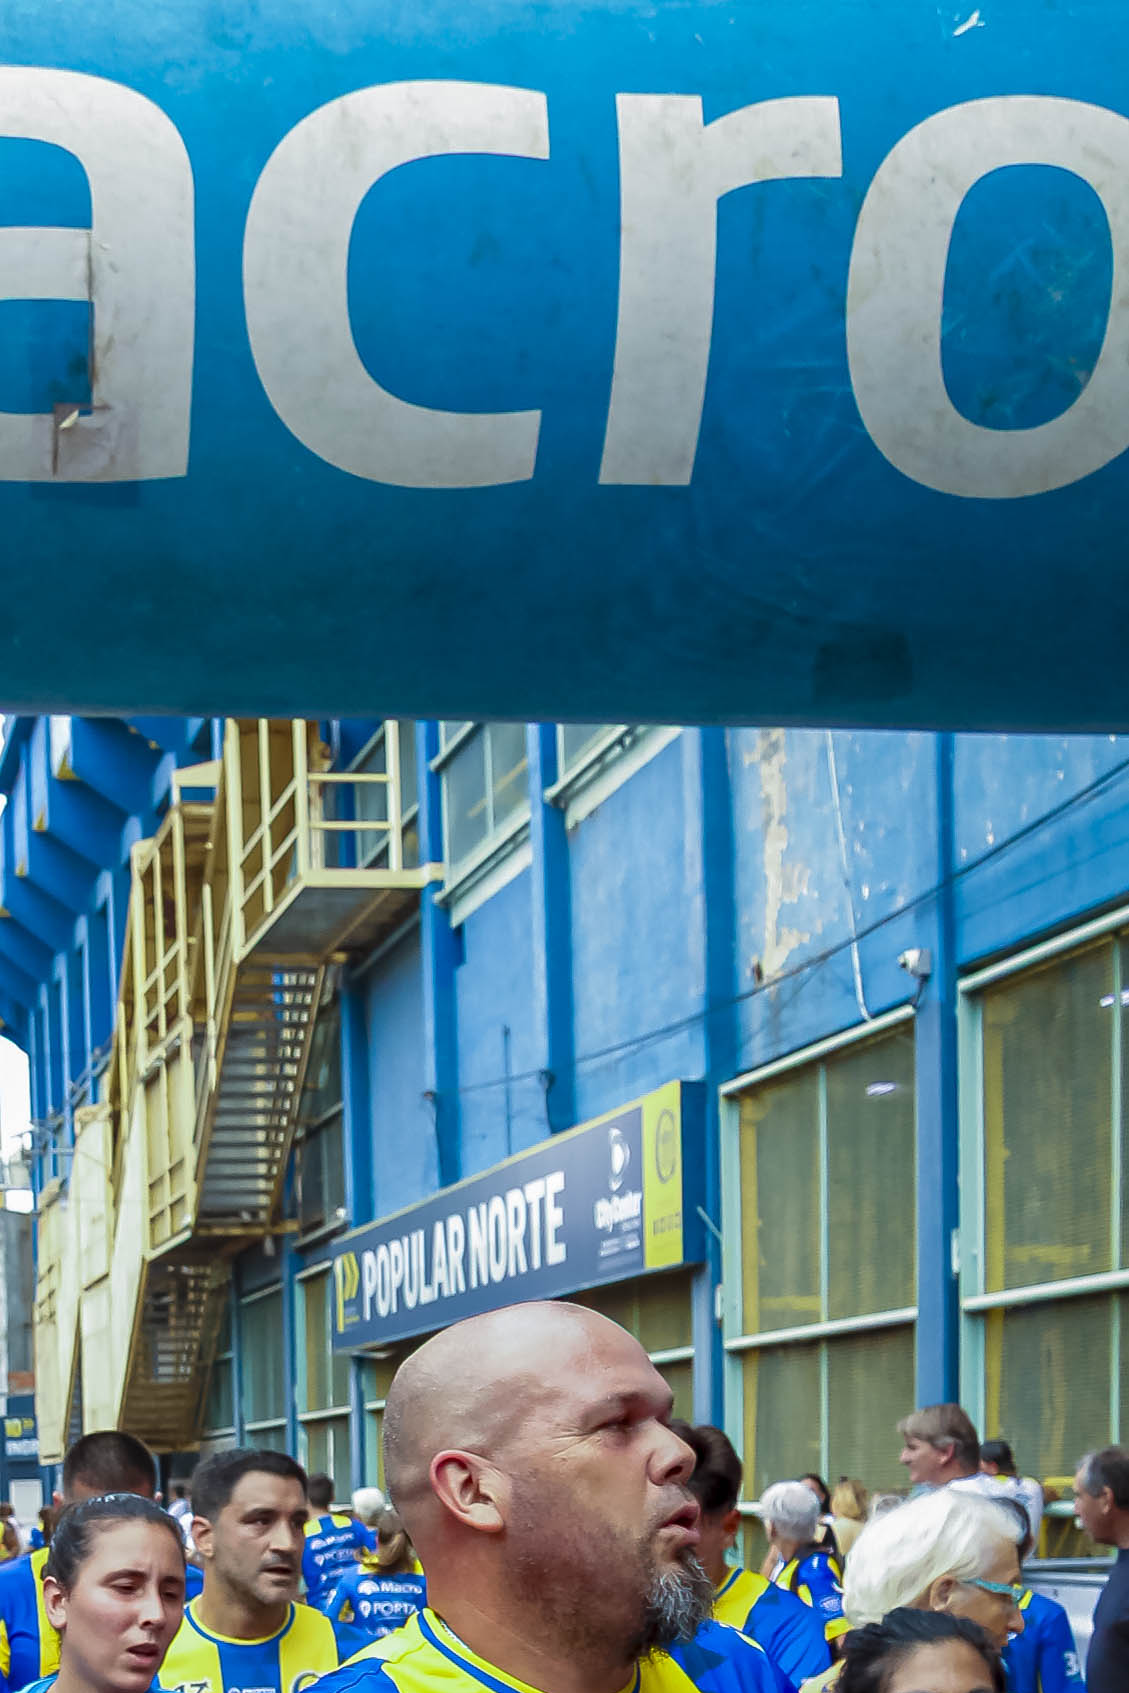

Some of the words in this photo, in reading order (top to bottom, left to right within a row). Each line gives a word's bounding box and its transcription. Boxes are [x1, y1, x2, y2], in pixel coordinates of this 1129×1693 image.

[362, 1214, 466, 1321] POPULAR
[467, 1171, 567, 1290] NORTE
[381, 1583, 423, 1594] Macro
